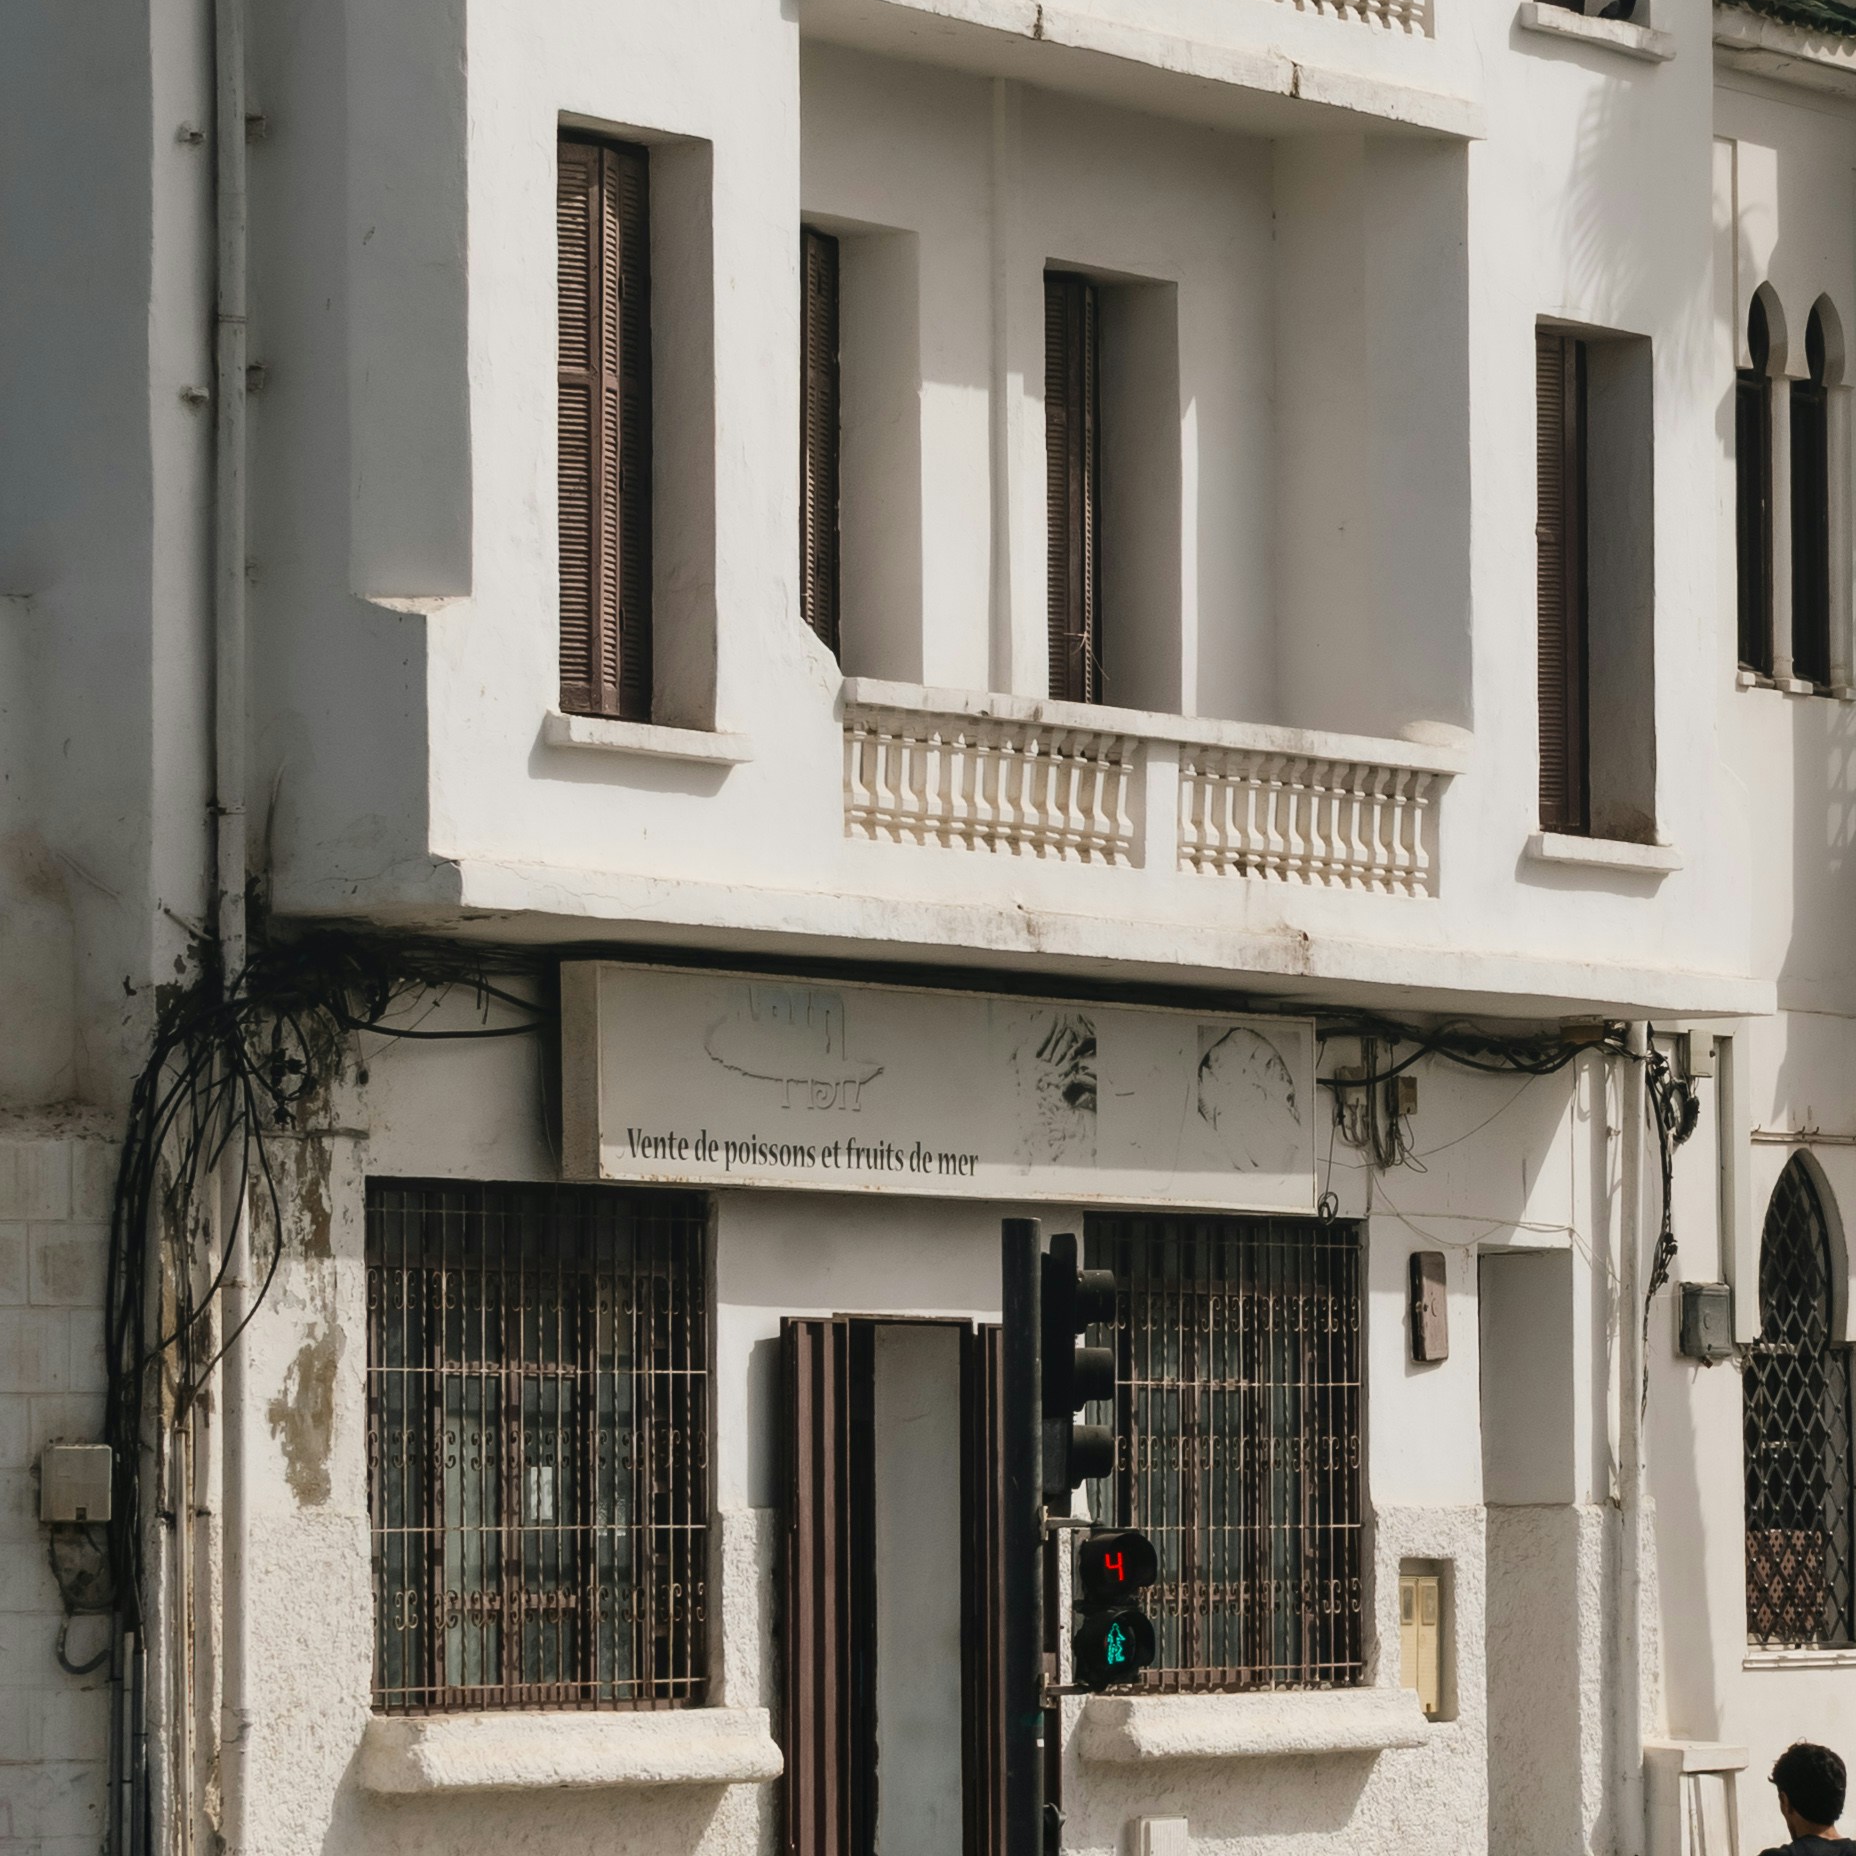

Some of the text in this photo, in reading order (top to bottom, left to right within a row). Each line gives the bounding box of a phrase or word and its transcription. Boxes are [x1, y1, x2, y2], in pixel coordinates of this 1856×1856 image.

[627, 1128, 979, 1176] Vente de poissons et fruits de mer
[1105, 1552, 1123, 1581] 4
